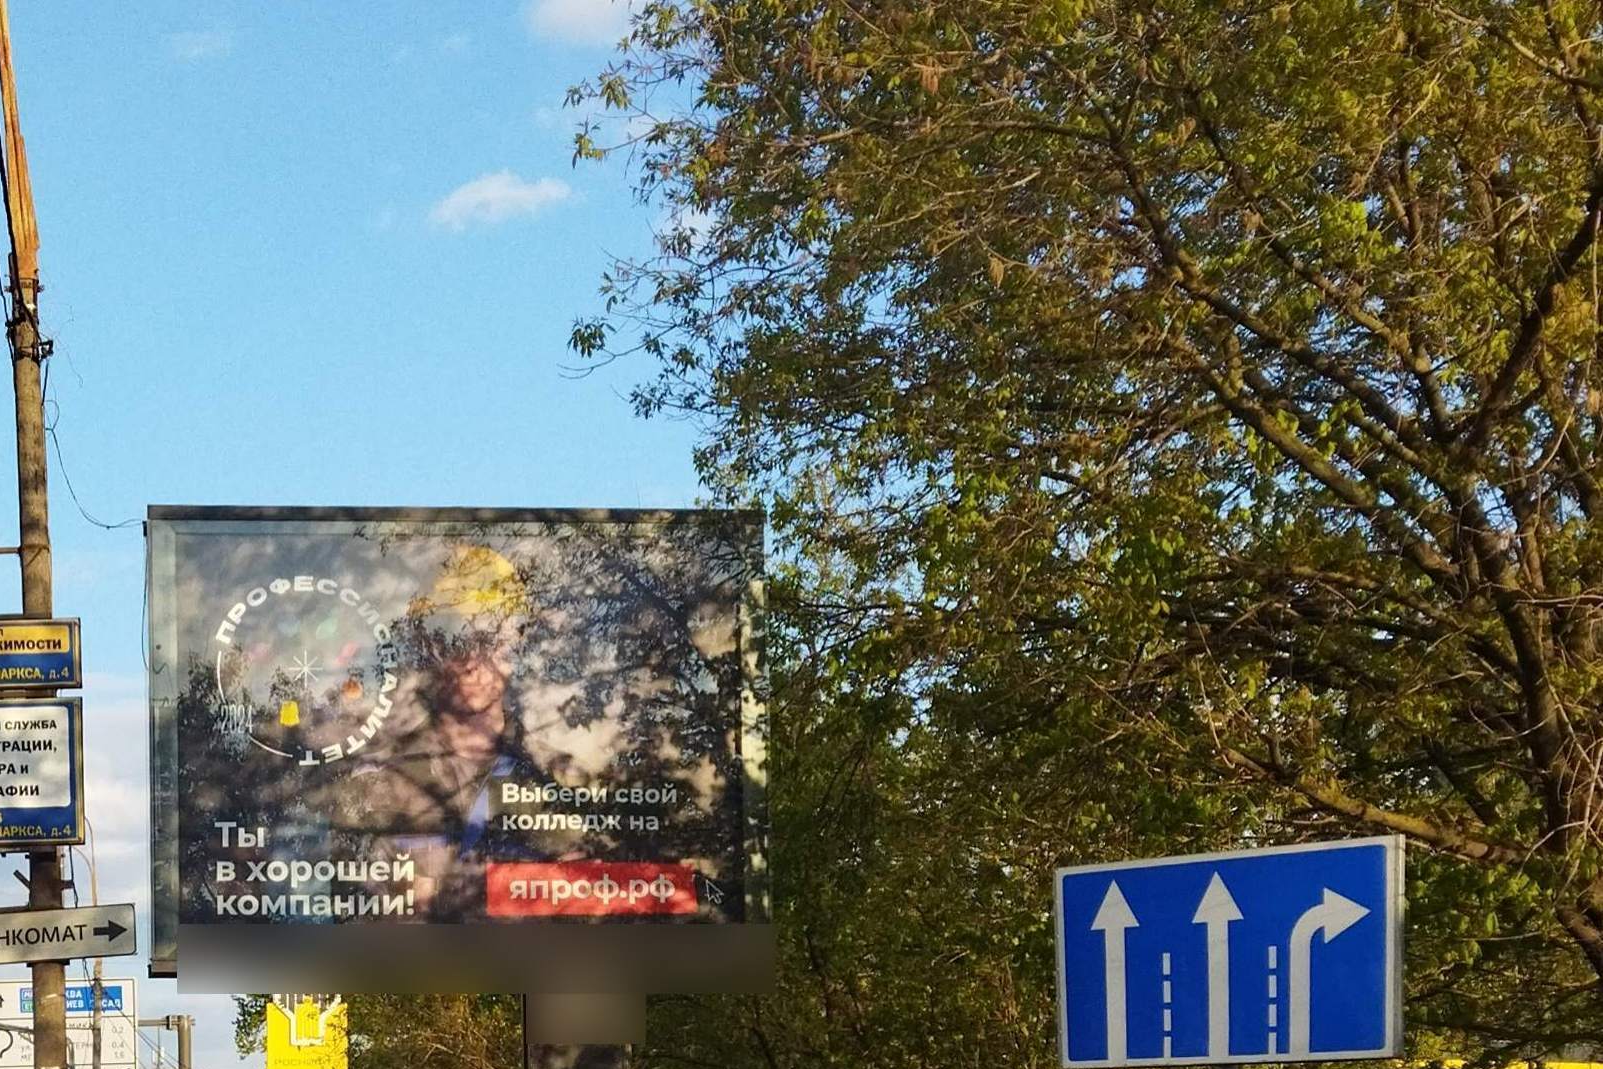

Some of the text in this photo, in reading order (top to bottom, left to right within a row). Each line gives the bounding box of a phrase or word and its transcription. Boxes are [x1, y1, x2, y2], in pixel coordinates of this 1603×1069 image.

[215, 575, 398, 766] ПРОФЕССИОНАЛИТЕТ
[4, 719, 57, 731] СЛУЖБА
[501, 782, 678, 807] Выбери свой
[214, 821, 265, 848] Ты
[501, 813, 660, 832] колледж на
[216, 853, 415, 888] в хорошей
[509, 873, 676, 904] япроф.рф
[216, 889, 415, 916] компании!
